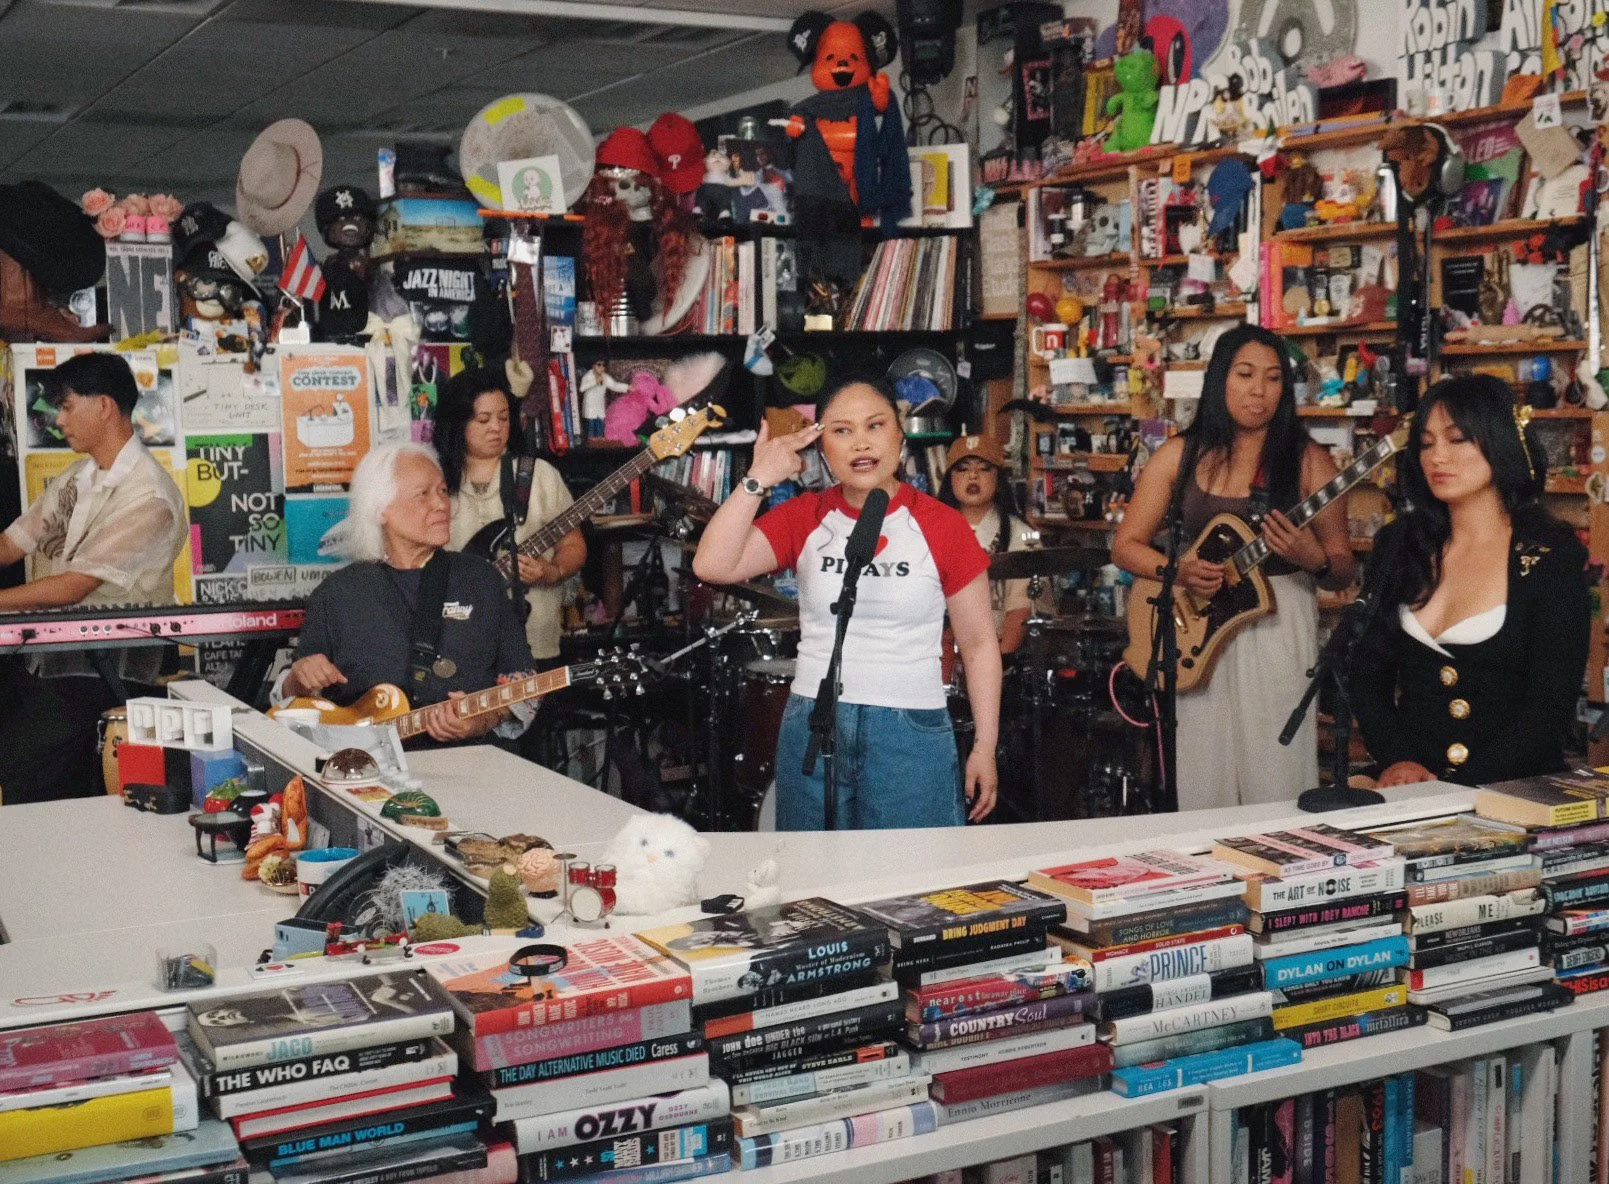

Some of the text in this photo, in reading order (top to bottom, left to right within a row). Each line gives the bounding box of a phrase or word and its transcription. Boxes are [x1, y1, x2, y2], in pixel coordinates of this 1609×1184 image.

[1402, 0, 1477, 54] Robin
[1230, 38, 1274, 95] Bob
[1403, 46, 1496, 118] Hilton
[1151, 78, 1222, 145] NPR
[403, 268, 476, 291] JAZZ NIGHT
[427, 286, 476, 301] IN AMERICA
[292, 375, 357, 387] CONTEST
[198, 444, 247, 463] TINY
[197, 461, 249, 482] BUT-
[231, 492, 278, 513] NOT
[249, 515, 279, 531] SO
[228, 533, 281, 552] TINY
[820, 555, 910, 578] PIAYS
[200, 581, 233, 597] NICK
[223, 613, 278, 629] oland
[1273, 892, 1285, 902] THE
[1287, 885, 1305, 901] ART
[1318, 877, 1351, 896] NOISE
[942, 923, 968, 941] BRING
[969, 918, 1010, 937] JUDGMENT
[1011, 915, 1028, 928] DAY
[1275, 914, 1297, 929] SLEPT
[1299, 911, 1318, 926] WITH
[1415, 903, 1494, 928] PLEASE ME
[807, 940, 849, 960] LOUIS
[785, 957, 872, 985] ARMSTRONG
[1150, 944, 1208, 982] PRINCE
[1277, 950, 1392, 982] DYLAN ON DYLAN
[1155, 989, 1209, 1009] HANDEL
[505, 1013, 614, 1044] SONGWRITERS
[949, 1003, 1048, 1037] COUNTRY Soul
[1151, 1005, 1241, 1033] McCARTNEY
[265, 1036, 314, 1061] JACO
[512, 1028, 624, 1057] SONGWRITING
[722, 1041, 742, 1054] JOHN
[743, 1034, 763, 1050] doe
[764, 1028, 791, 1045] UNDER
[792, 1025, 806, 1038] the
[216, 1072, 252, 1092] THE
[255, 1063, 307, 1085] WHO
[312, 1055, 350, 1076] FAQ
[500, 1042, 679, 1084] THE DAY ALTERNATIVE MUSIC DIED Caress
[1137, 1079, 1173, 1094] BEALES
[947, 1093, 1032, 1118] Ennio Morricone
[537, 1102, 658, 1141] I AM OZZY
[278, 1122, 406, 1157] BLUE MAN WORLD
